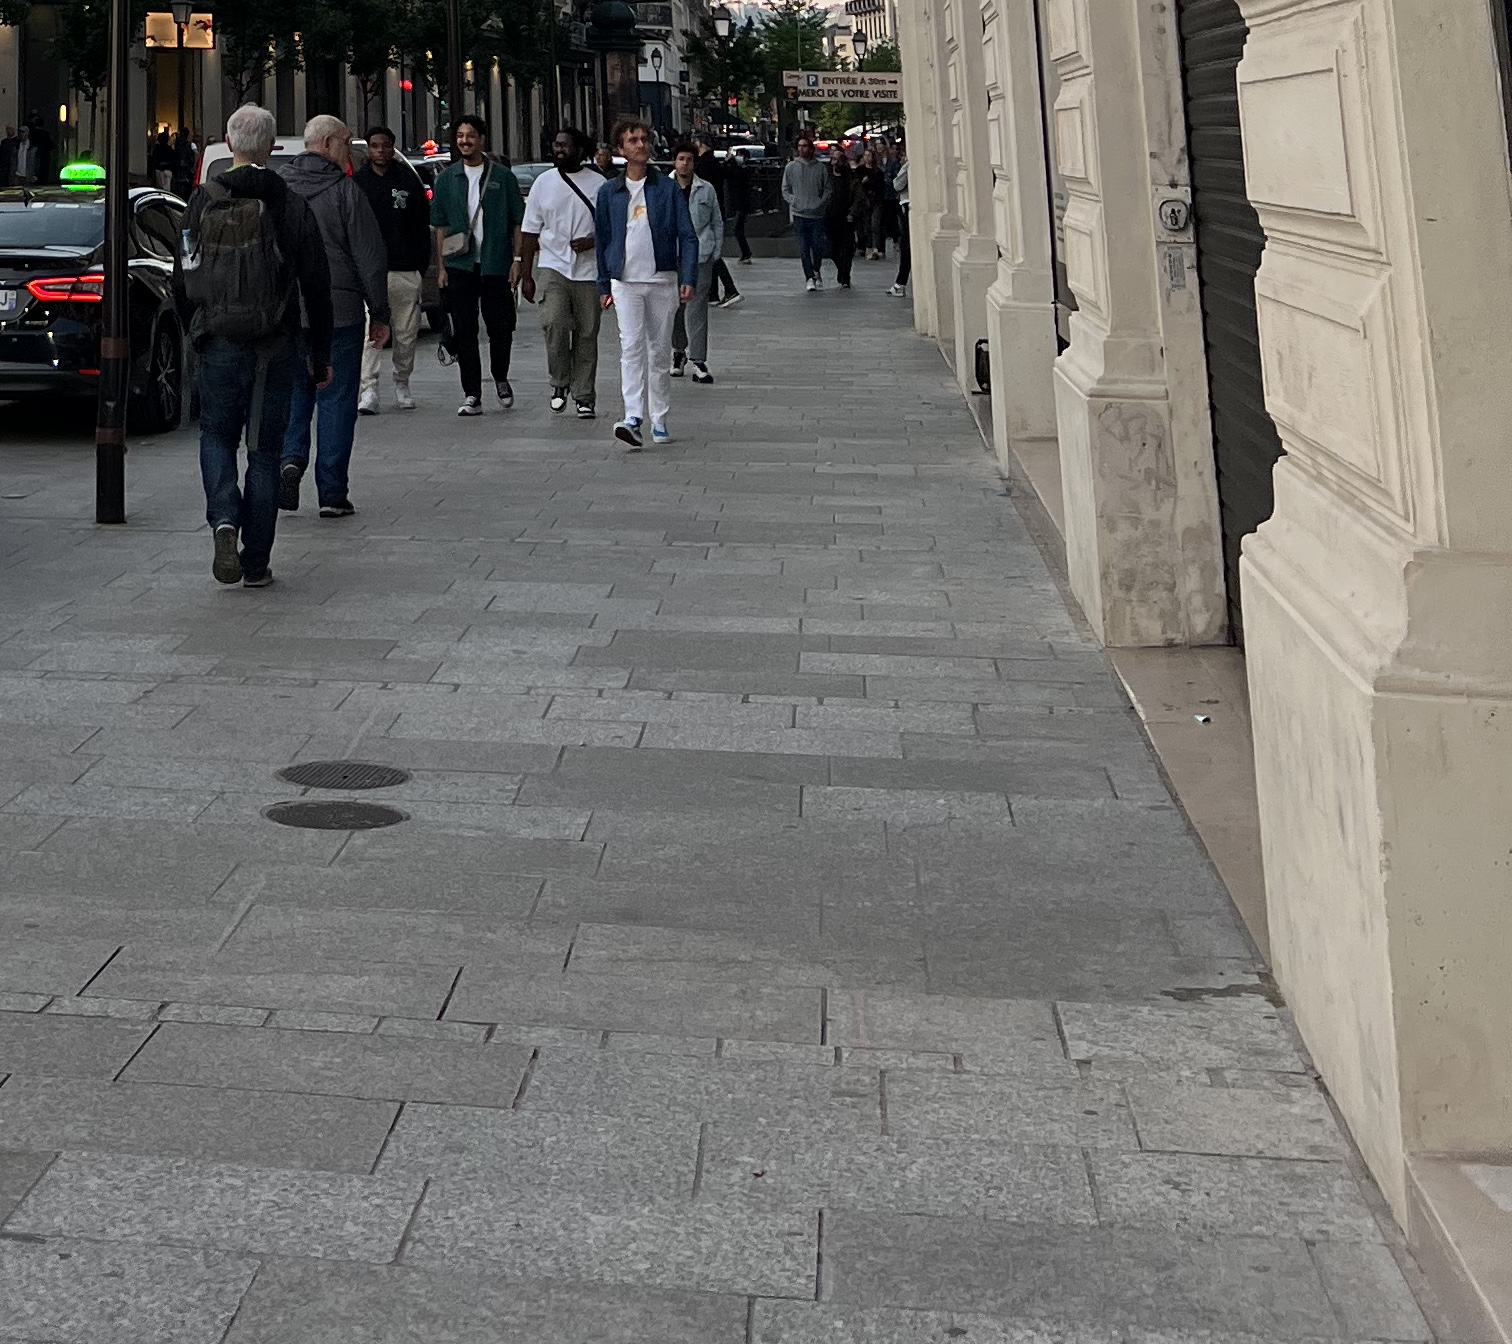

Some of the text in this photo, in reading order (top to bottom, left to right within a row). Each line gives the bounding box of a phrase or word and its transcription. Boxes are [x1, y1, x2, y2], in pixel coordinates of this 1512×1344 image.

[822, 75, 858, 85] ENTRÉE
[827, 88, 839, 98] DE
[841, 89, 870, 99] VOTRE
[871, 89, 898, 99] VISITE
